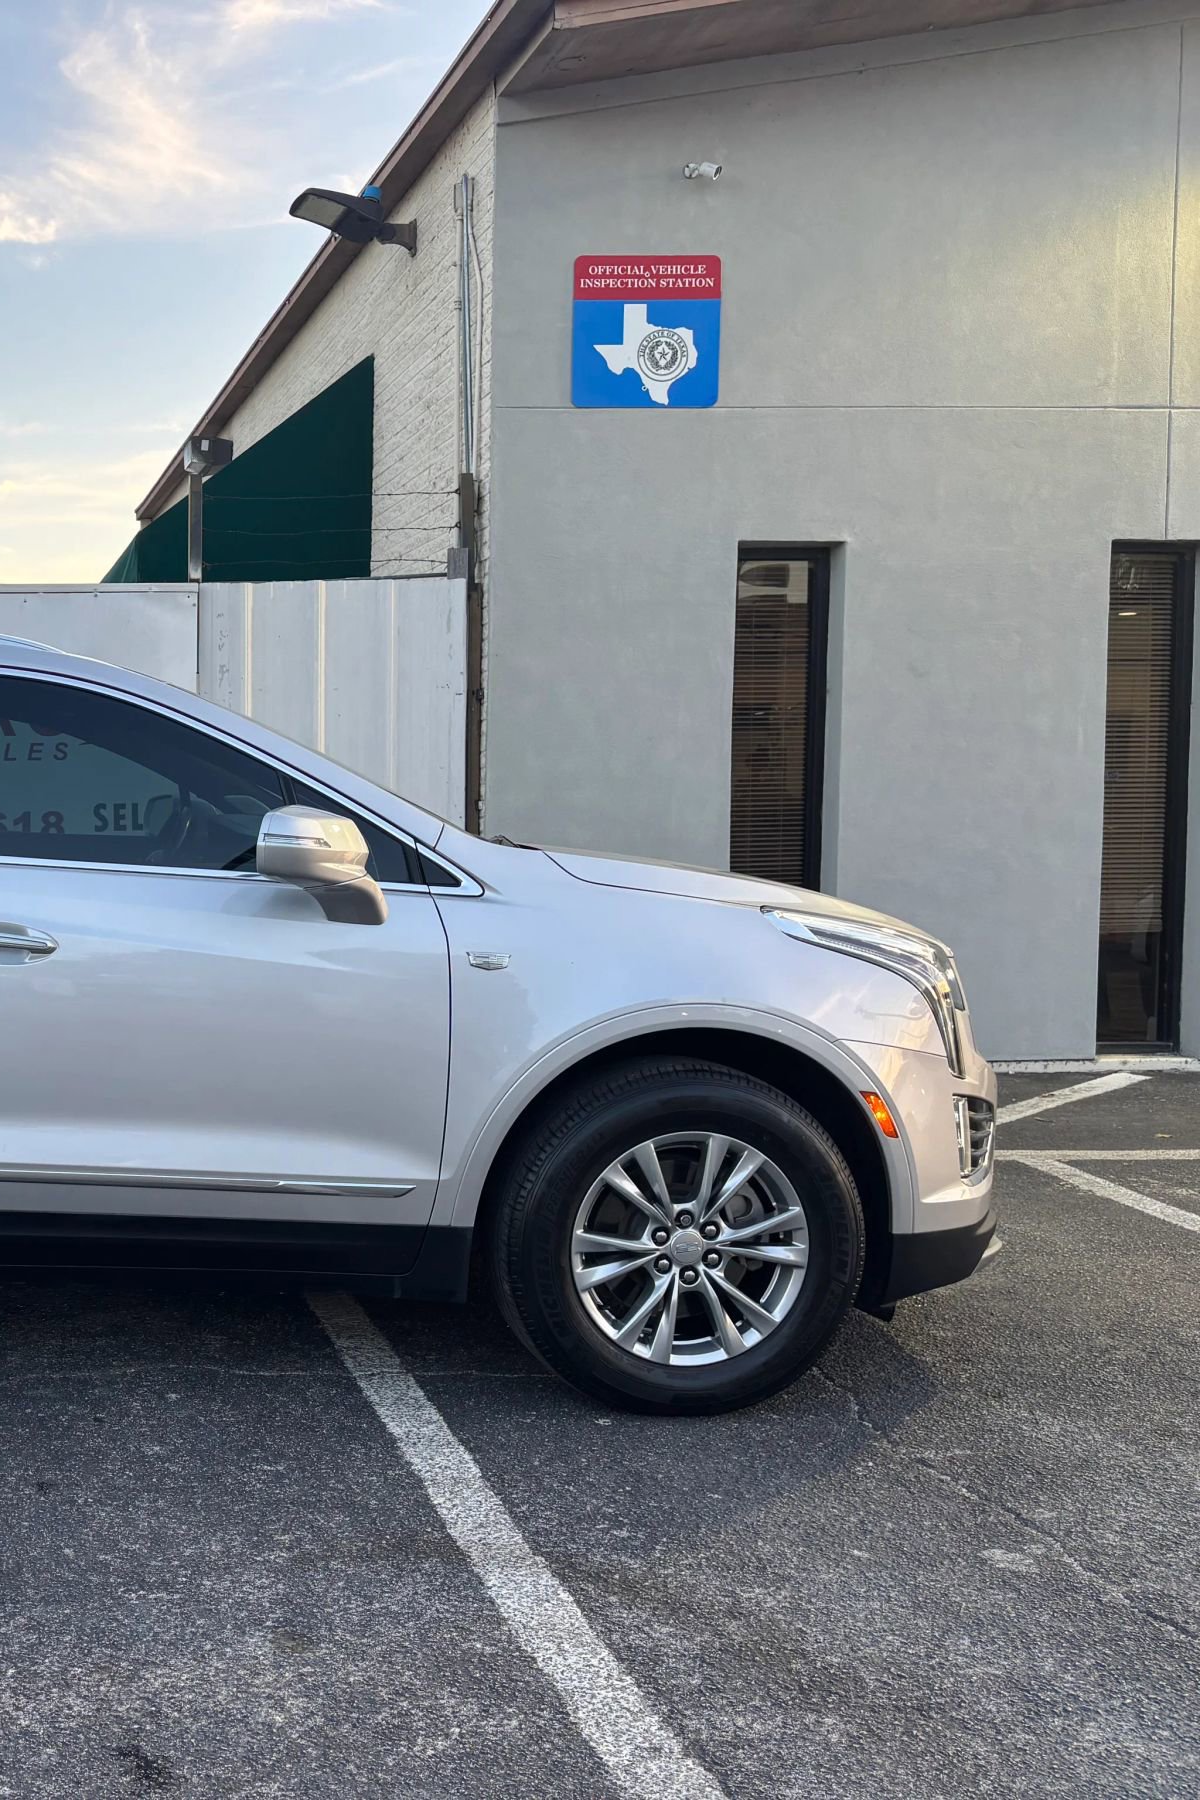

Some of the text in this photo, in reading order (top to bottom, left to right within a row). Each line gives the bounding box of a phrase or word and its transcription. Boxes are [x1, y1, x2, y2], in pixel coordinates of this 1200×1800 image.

[588, 264, 706, 275] OFFICIAL VEHICLE
[580, 277, 715, 288] INSPECTION STATION
[93, 802, 143, 833] SEL
